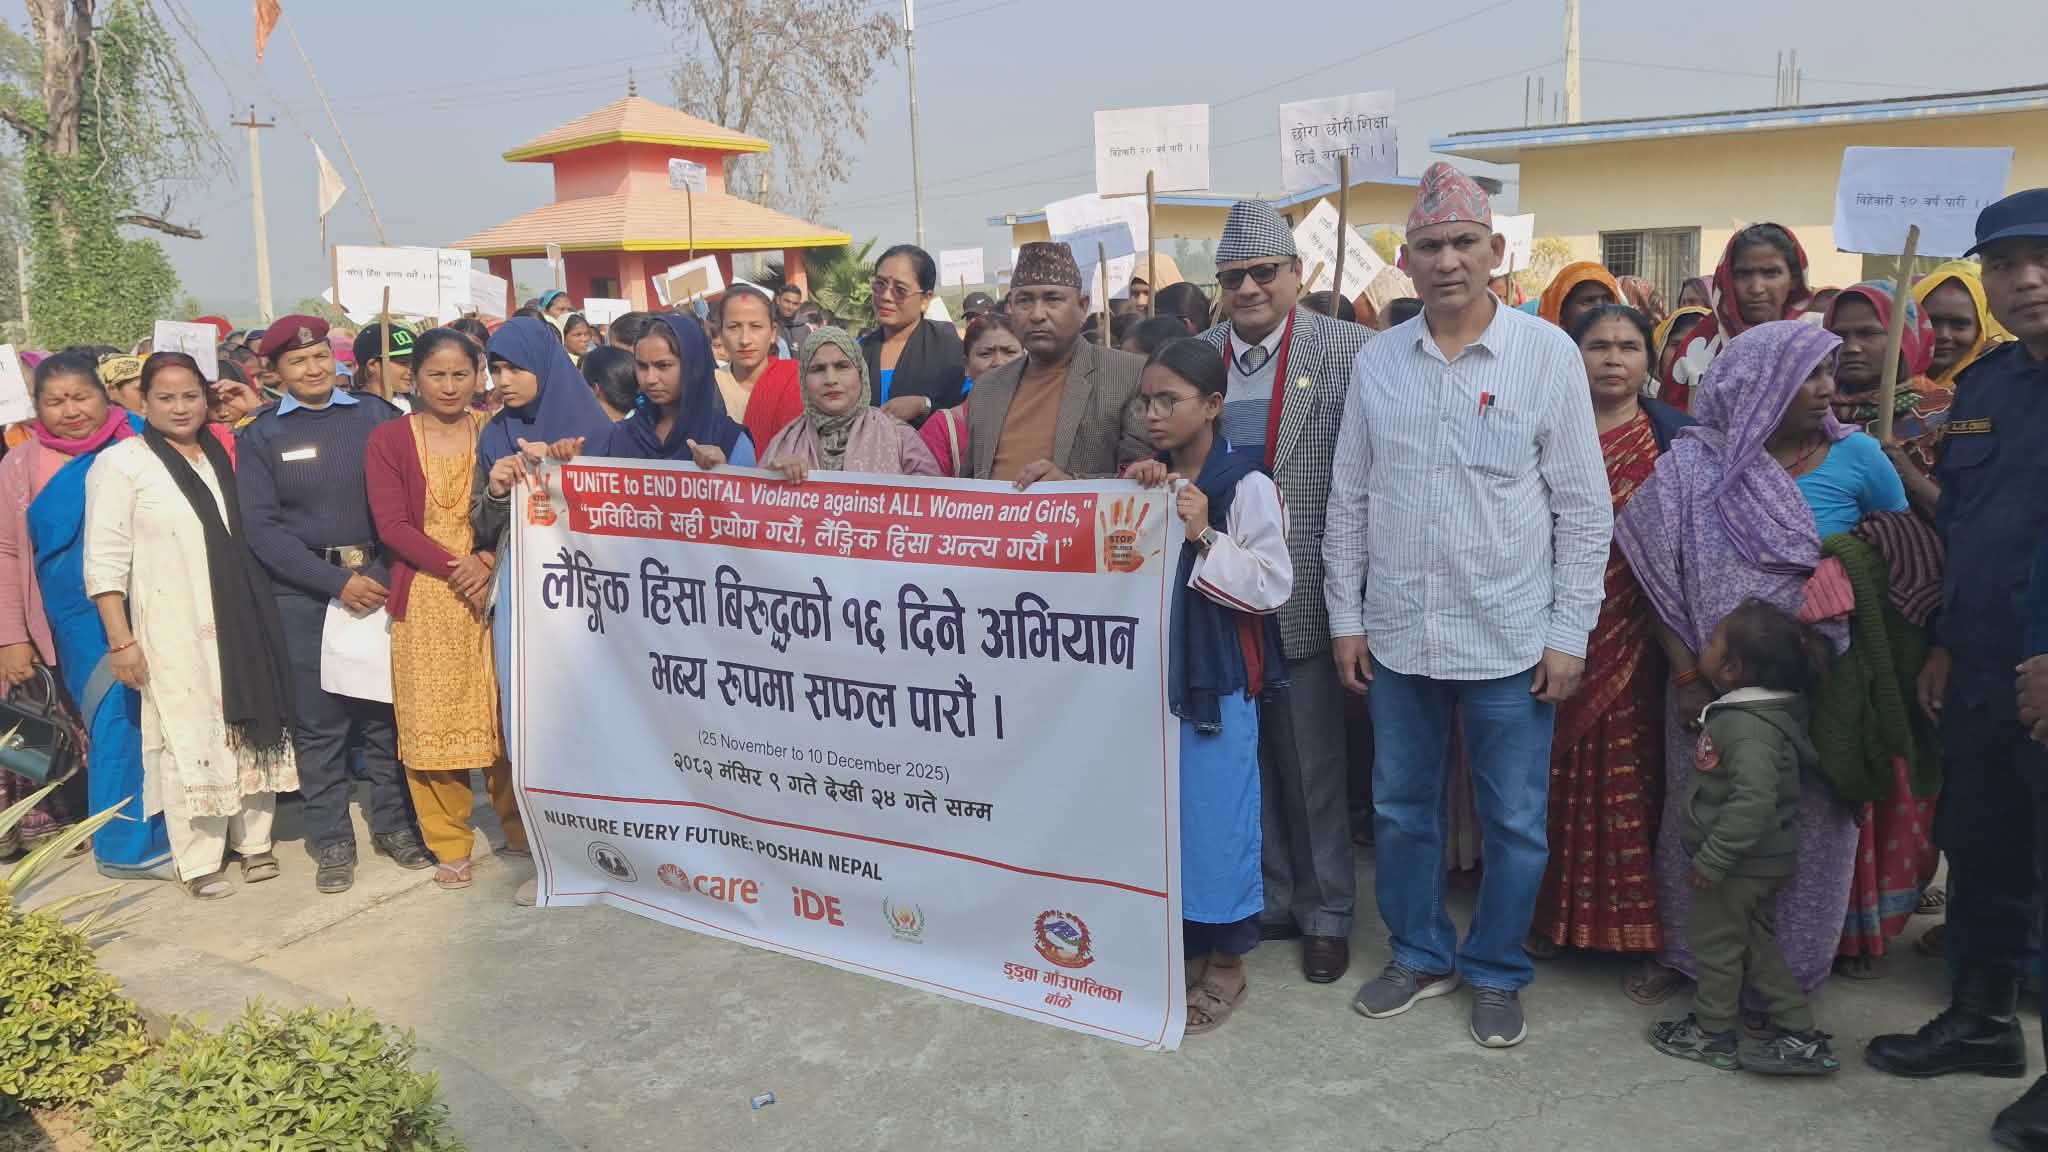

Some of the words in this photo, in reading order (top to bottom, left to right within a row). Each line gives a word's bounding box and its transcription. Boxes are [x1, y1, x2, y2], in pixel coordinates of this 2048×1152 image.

[1326, 117, 1352, 136] छोरी
[1357, 114, 1390, 132] शिक्षा
[624, 476, 640, 496] to
[643, 475, 677, 498] END
[681, 476, 745, 504] DIGITAL
[750, 482, 820, 510] Violance
[824, 490, 886, 520] against
[889, 493, 924, 517] ALL
[930, 495, 995, 521] Women
[998, 500, 1033, 523] and
[669, 507, 704, 539] सही
[710, 511, 760, 540] प्रयोग
[886, 523, 934, 558] हिंसा
[937, 532, 1000, 561] अन्त्य
[1109, 535, 1133, 544] STOP
[640, 556, 706, 626] हिंसा
[842, 597, 886, 655] १६
[898, 583, 966, 657] दिने
[978, 591, 1140, 670] अभियान
[803, 672, 897, 730] सफल
[698, 728, 717, 747] (25
[721, 735, 787, 759] November
[791, 748, 804, 762] to
[808, 749, 823, 765] 10
[827, 751, 901, 777] December
[905, 761, 951, 785] 2025)
[673, 751, 713, 780] २०८२
[718, 758, 763, 787] मंसिर
[769, 772, 781, 793] ९
[788, 773, 817, 797] गते
[824, 776, 864, 803] देखी
[872, 788, 897, 810] २४
[904, 789, 938, 814] गते
[944, 797, 994, 822] सम्म
[544, 809, 618, 836] NURTURE
[623, 821, 681, 841] EVERY
[686, 826, 755, 852] FUTURE:
[757, 839, 823, 869] POSHAN
[828, 854, 884, 881] NEPAL
[693, 872, 759, 905] care
[791, 886, 845, 927] iDE
